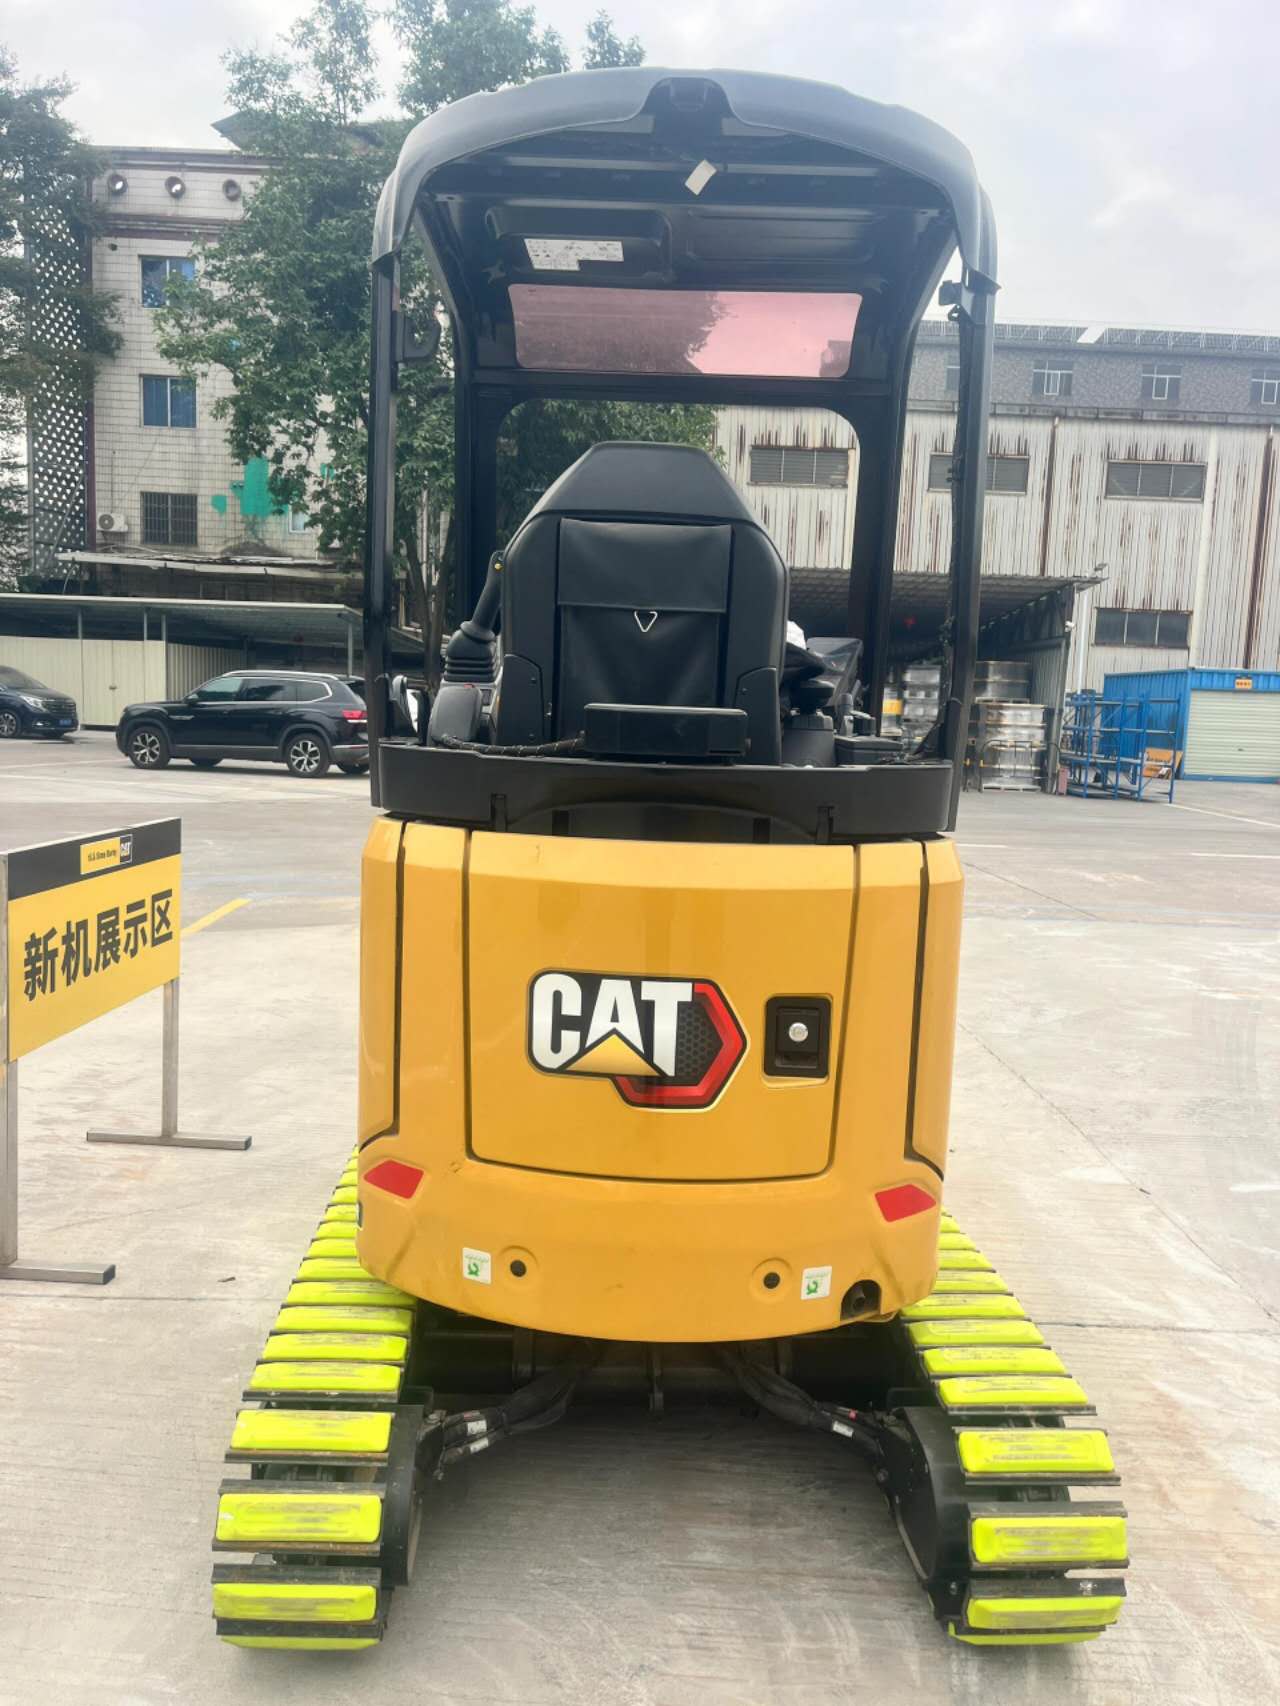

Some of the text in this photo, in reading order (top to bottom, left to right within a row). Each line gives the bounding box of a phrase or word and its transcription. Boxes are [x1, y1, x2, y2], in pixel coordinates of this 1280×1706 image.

[24, 889, 173, 1001] 新机展示区
[533, 973, 692, 1077] CAT
